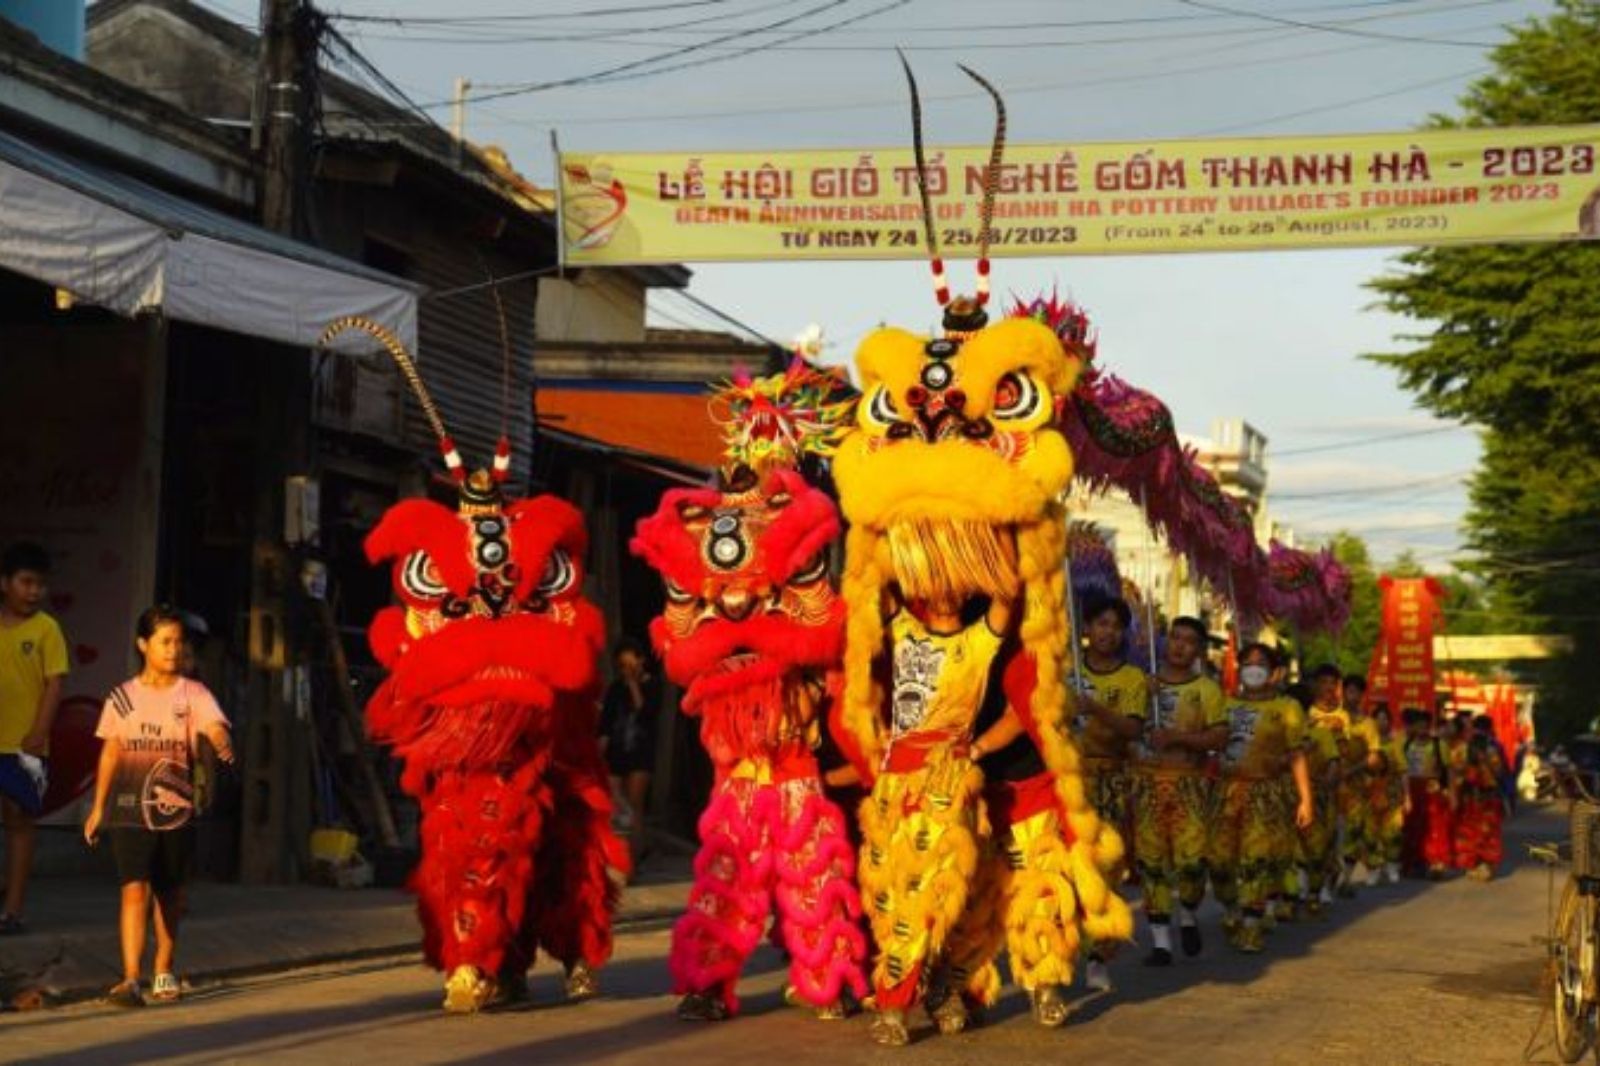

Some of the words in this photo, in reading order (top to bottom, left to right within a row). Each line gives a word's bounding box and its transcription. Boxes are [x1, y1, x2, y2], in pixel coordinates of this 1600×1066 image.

[658, 158, 706, 200] LỄ
[720, 162, 793, 205] HỘI
[1095, 149, 1187, 192] GỐM
[1202, 153, 1352, 189] THANH
[1368, 144, 1430, 184] HÀ
[1482, 144, 1595, 178] 2023
[938, 202, 966, 219] OF
[976, 199, 1058, 219] THANH
[1069, 198, 1101, 216] HA
[1111, 195, 1217, 217] POTTERY
[1229, 191, 1352, 213] VILLAGE'S
[1361, 186, 1479, 208] FOUNDER
[1489, 182, 1559, 203] 2023
[888, 229, 917, 247] 24
[1104, 223, 1171, 242] (From
[1218, 223, 1243, 236] to
[1386, 213, 1449, 233] 2023)
